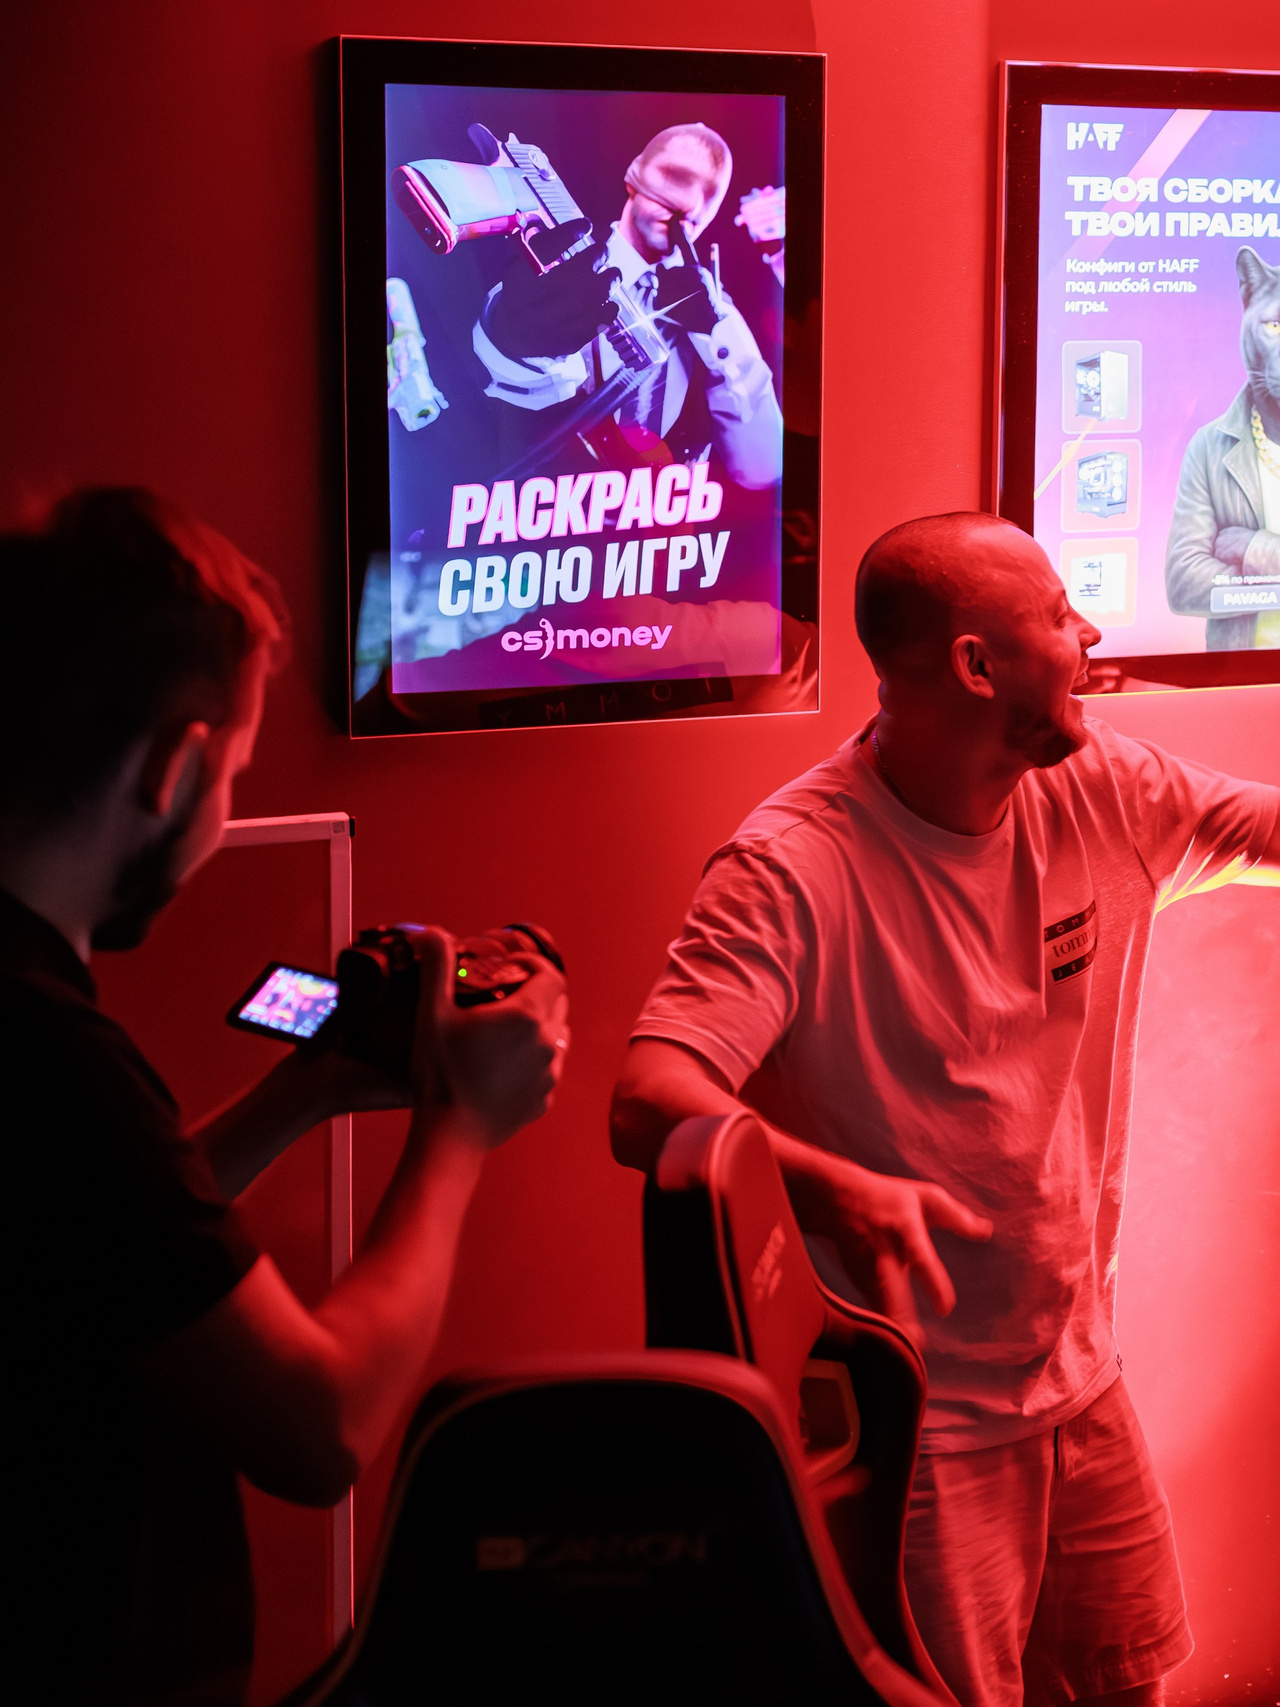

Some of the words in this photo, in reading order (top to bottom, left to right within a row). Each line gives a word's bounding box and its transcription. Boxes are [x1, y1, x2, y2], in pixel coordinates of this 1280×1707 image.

[1066, 122, 1124, 151] HAFF
[1067, 176, 1158, 203] ТВОЯ
[1064, 211, 1160, 237] ТВОИ
[1065, 257, 1136, 276] Конфиги
[1138, 260, 1156, 273] от
[1158, 258, 1199, 273] HAFF
[1065, 280, 1096, 295] под
[1098, 277, 1150, 293] любой
[1153, 280, 1197, 293] стиль
[1064, 300, 1109, 315] игры.
[446, 461, 724, 549] РАСКРАСЬ
[437, 546, 593, 617] СВОЮ
[602, 530, 731, 599] ИГРУ
[1223, 591, 1278, 606] PAVAGA
